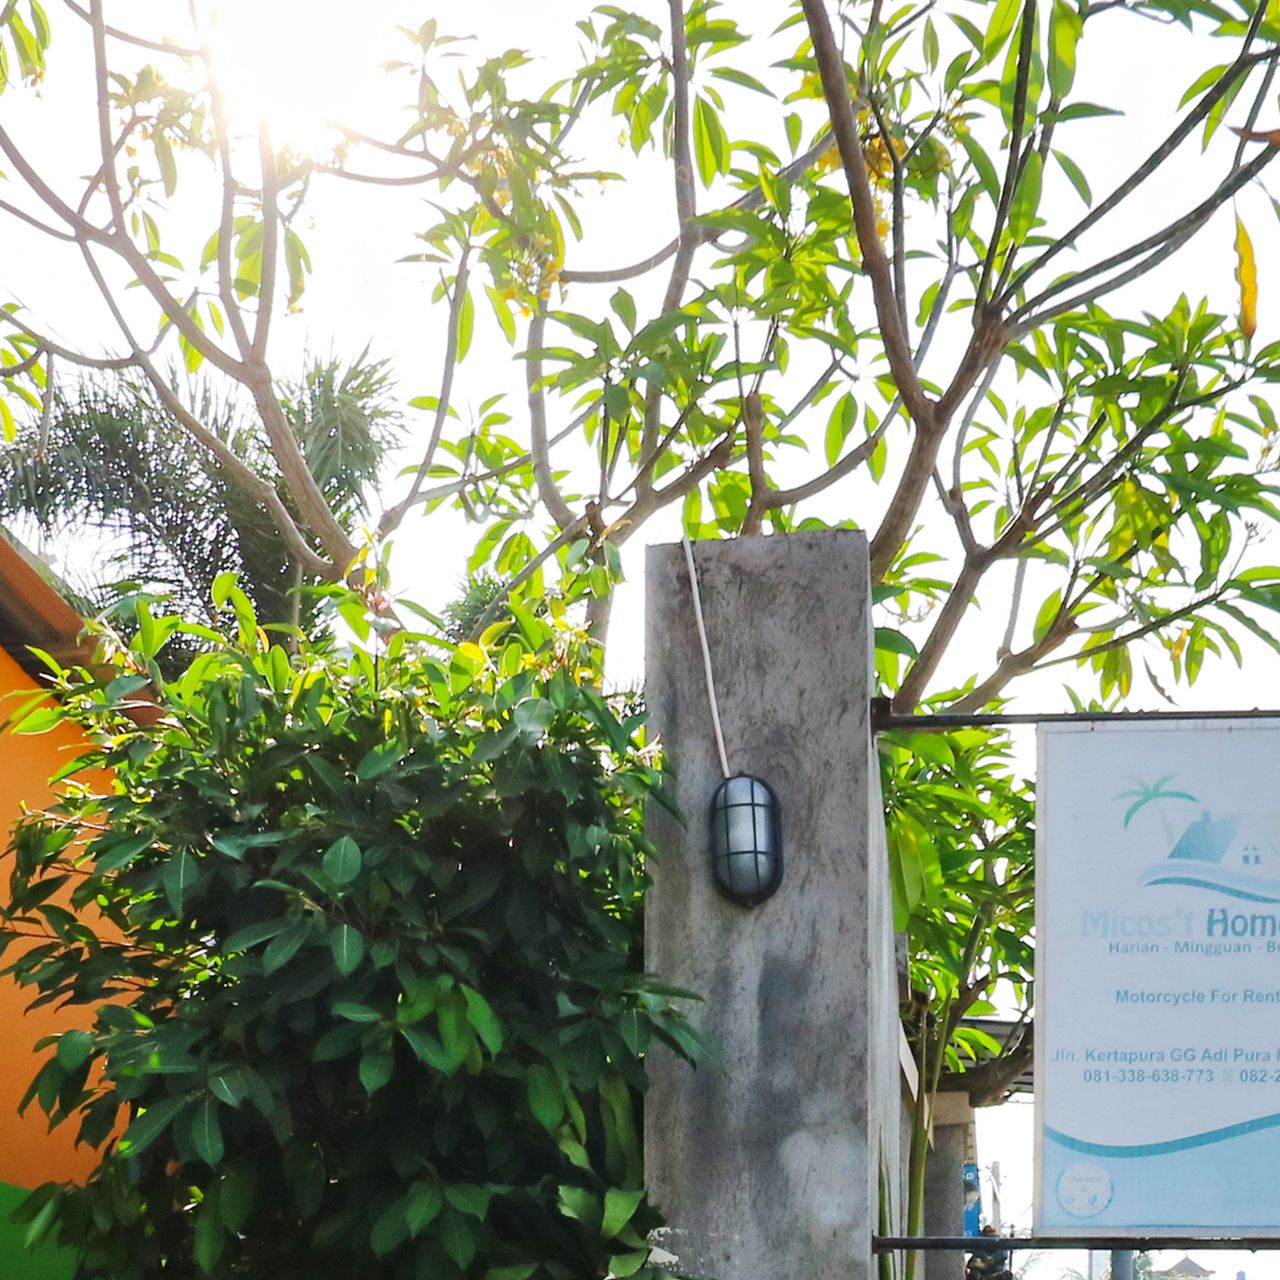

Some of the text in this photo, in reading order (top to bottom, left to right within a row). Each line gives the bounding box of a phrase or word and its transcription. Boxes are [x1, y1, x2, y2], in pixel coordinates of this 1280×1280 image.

[1108, 941, 1160, 953] Harian
[1173, 941, 1252, 956] Mingguan
[1115, 988, 1280, 1006] Motorcycle For Rent
[1085, 1048, 1165, 1065] Kertapura
[1170, 1047, 1196, 1062] GG
[1200, 1047, 1228, 1062] Adi
[1233, 1048, 1271, 1062] Pura
[1083, 1068, 1214, 1083] 081-338-638-773
